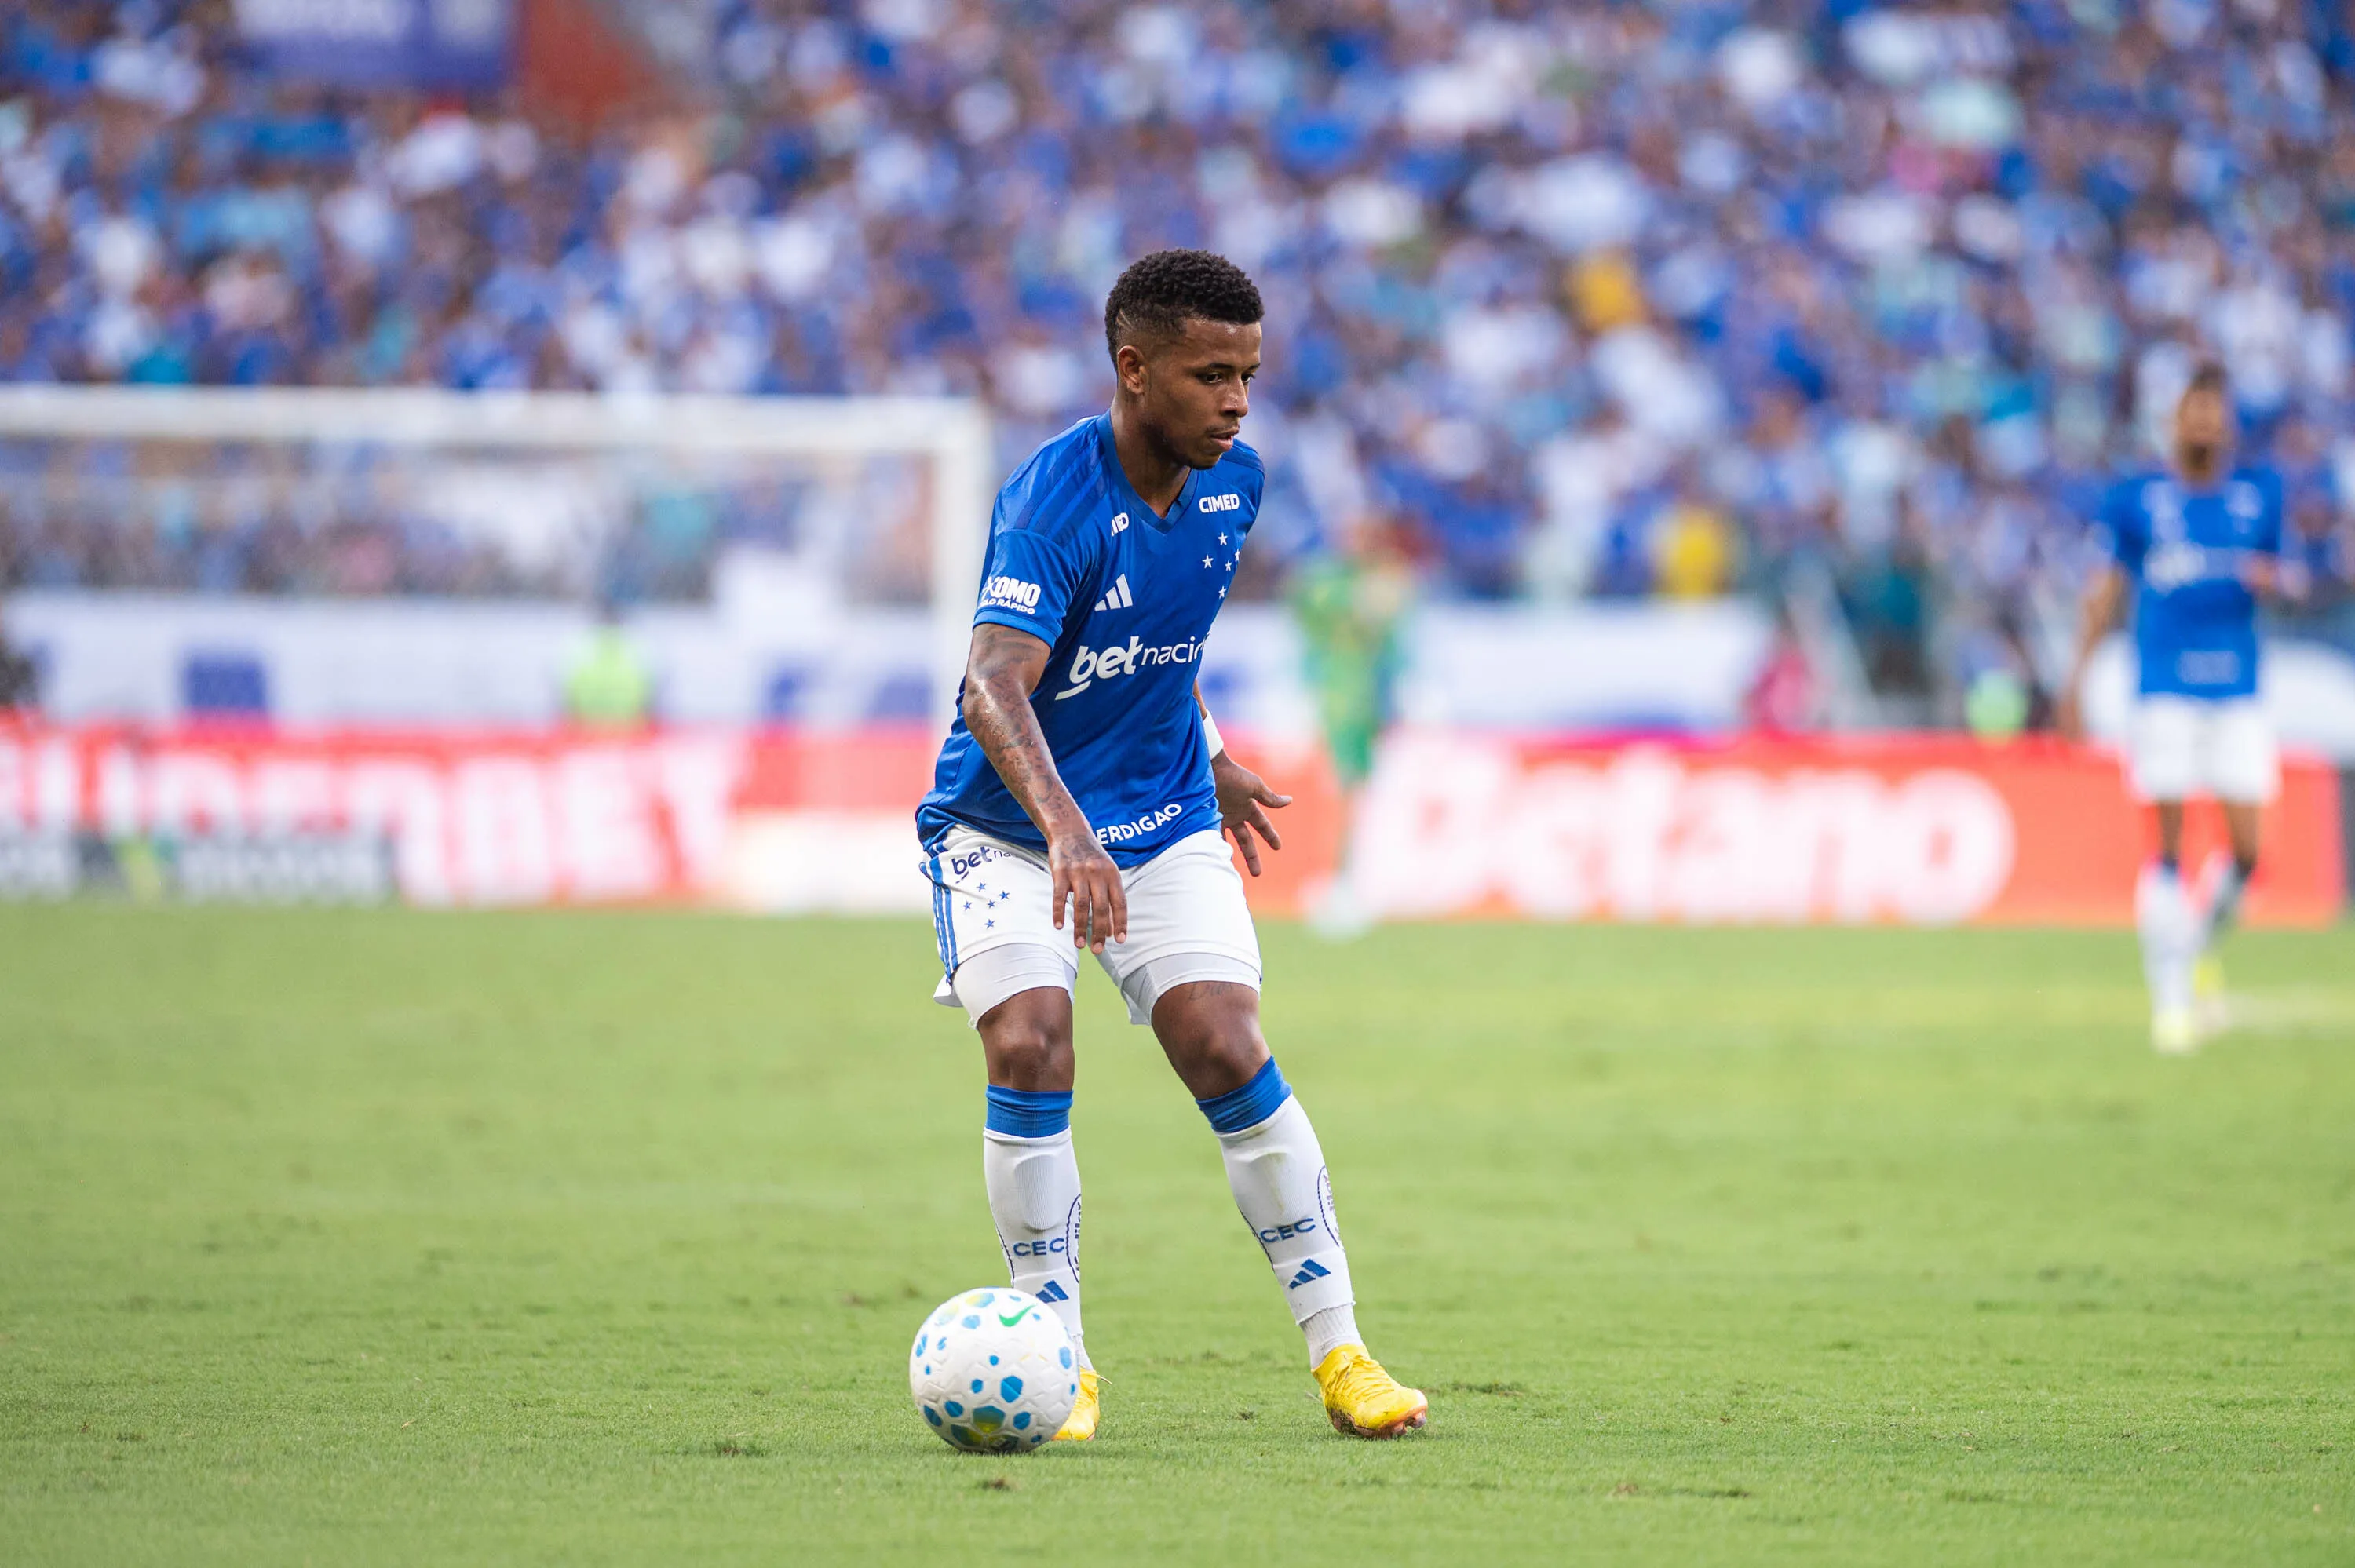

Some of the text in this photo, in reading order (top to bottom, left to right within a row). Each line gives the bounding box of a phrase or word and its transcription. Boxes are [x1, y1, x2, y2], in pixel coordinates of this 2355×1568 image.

[1199, 493, 1240, 513] CIMED
[1095, 803, 1182, 845] ERDIGAO
[1260, 1217, 1316, 1243] CEC
[1013, 1238, 1064, 1256] CEC
